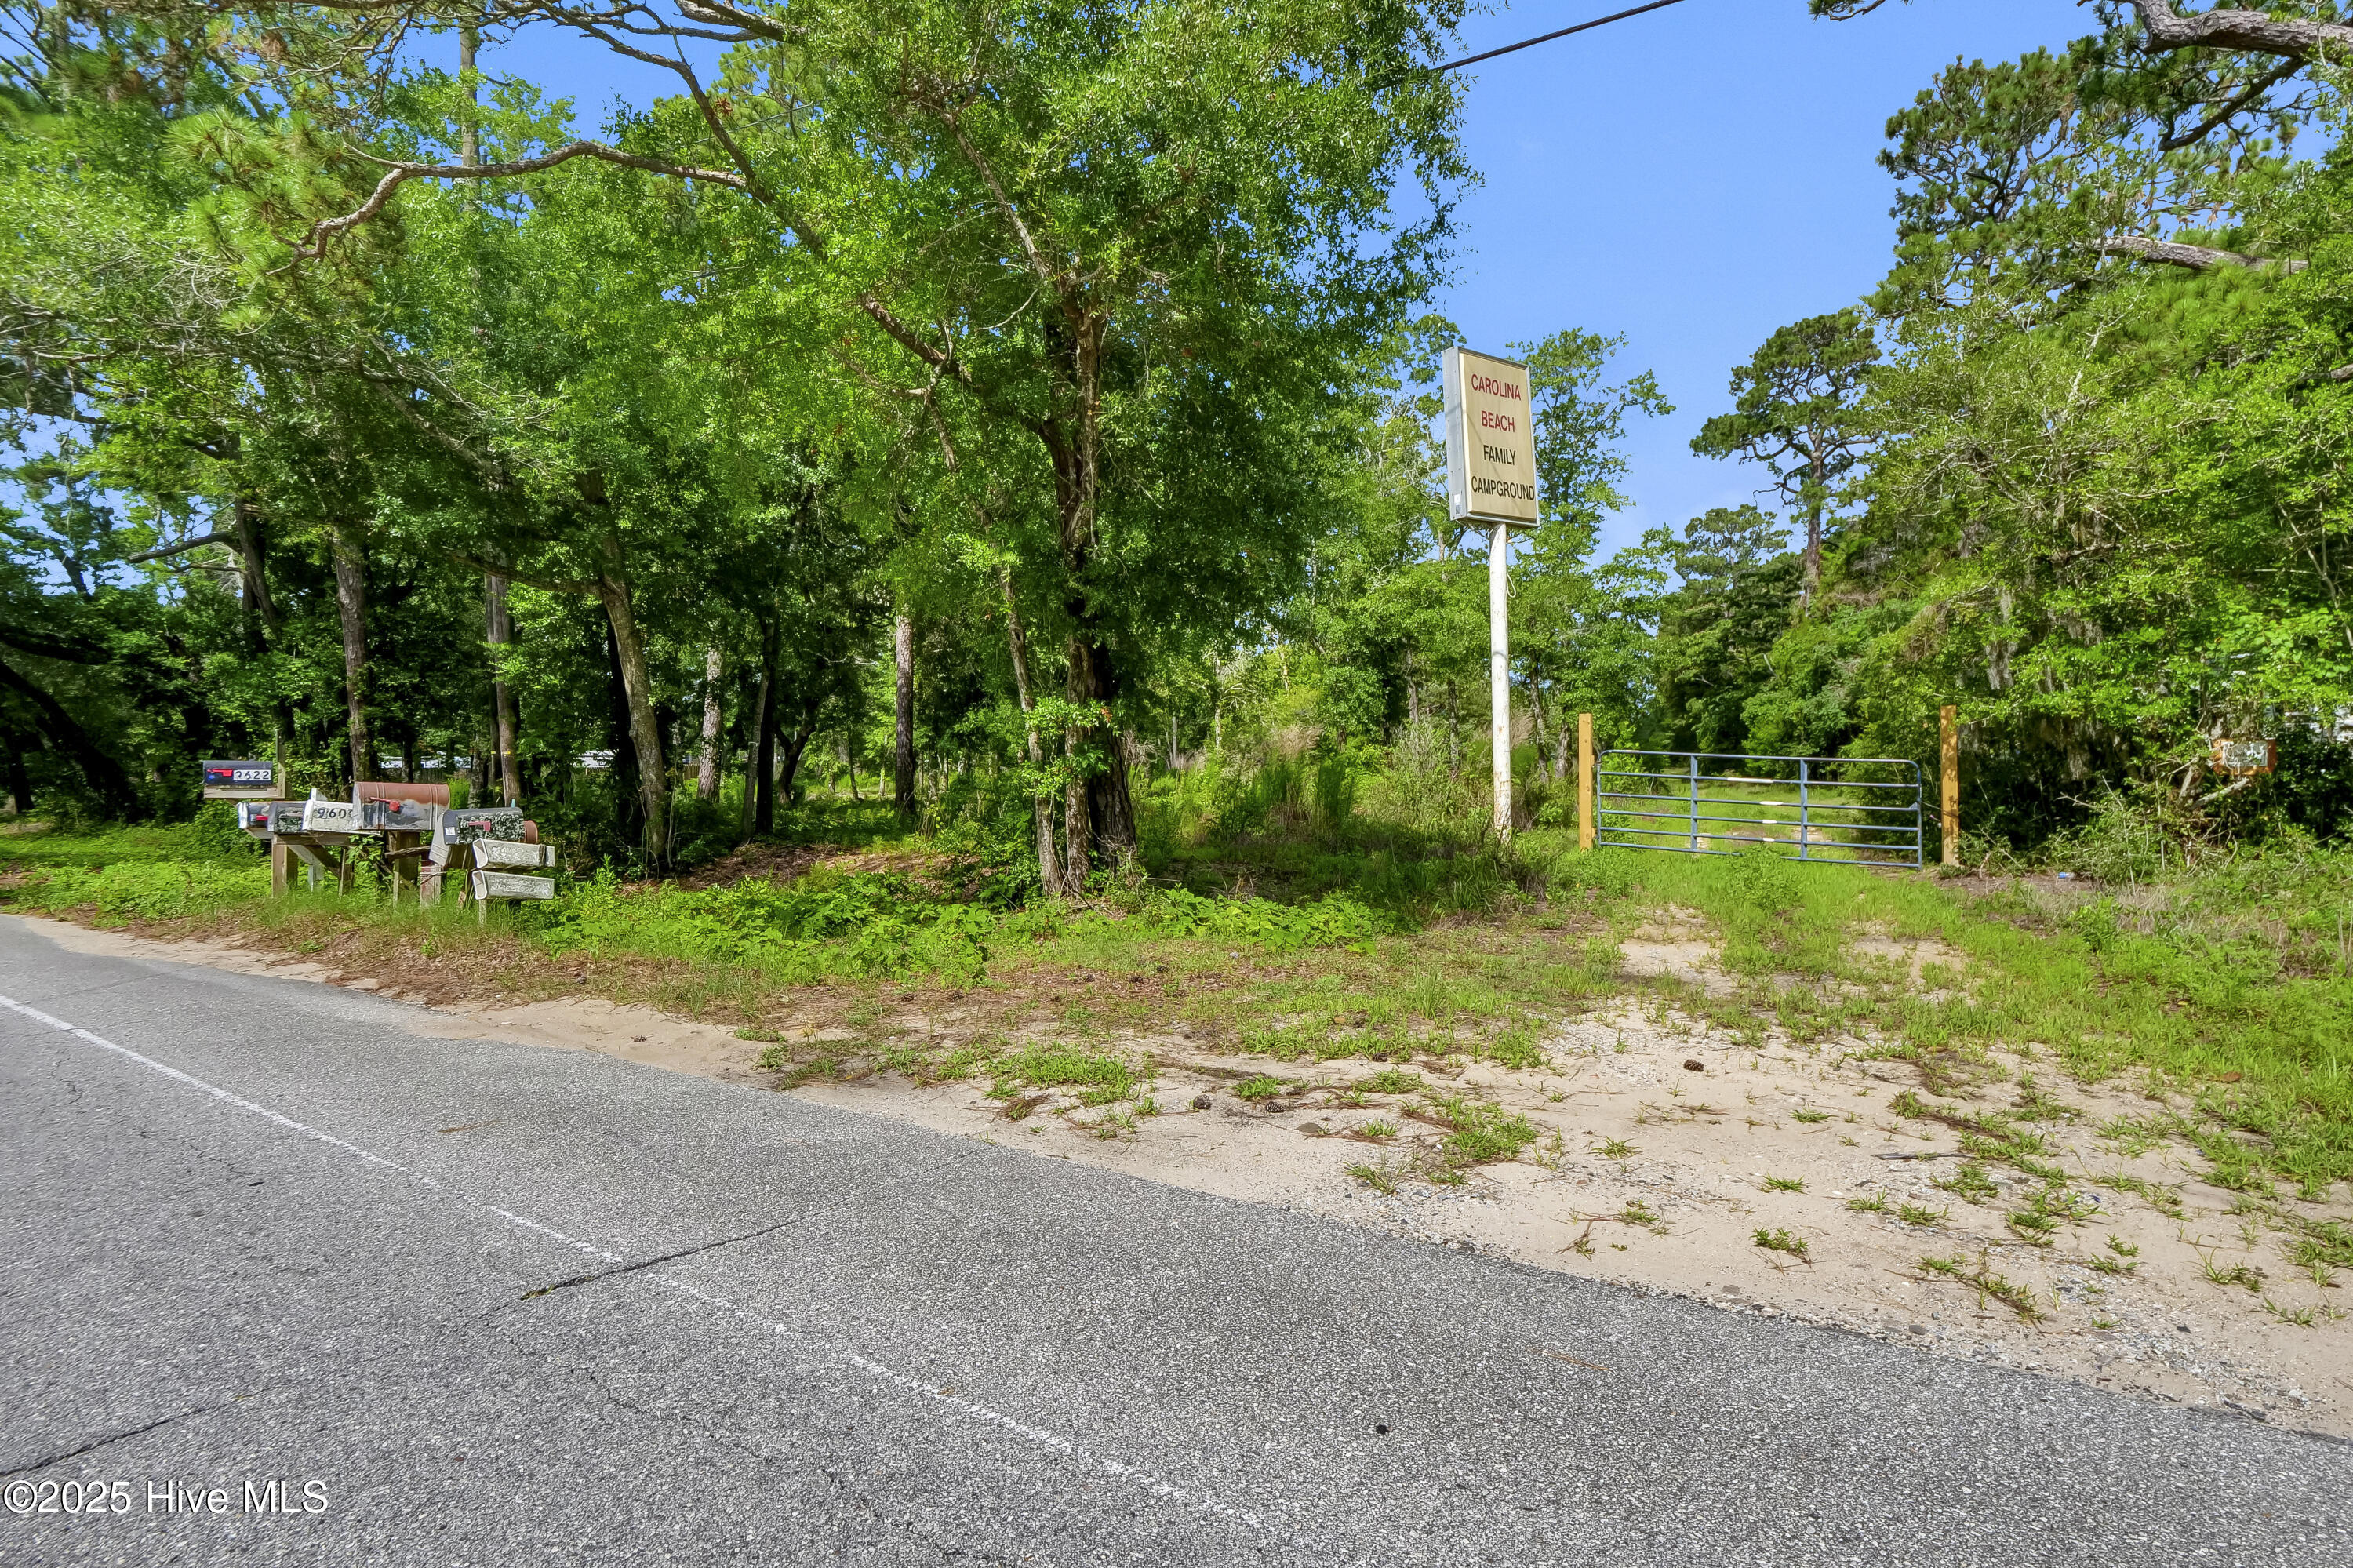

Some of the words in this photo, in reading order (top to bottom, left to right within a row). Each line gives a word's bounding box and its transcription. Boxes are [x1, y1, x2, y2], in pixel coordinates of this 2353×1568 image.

[1471, 373, 1521, 401] CAROLINA
[1482, 410, 1515, 432] BEACH
[1483, 445, 1515, 465] FAMILY
[1471, 475, 1534, 501] CAMPGROUND
